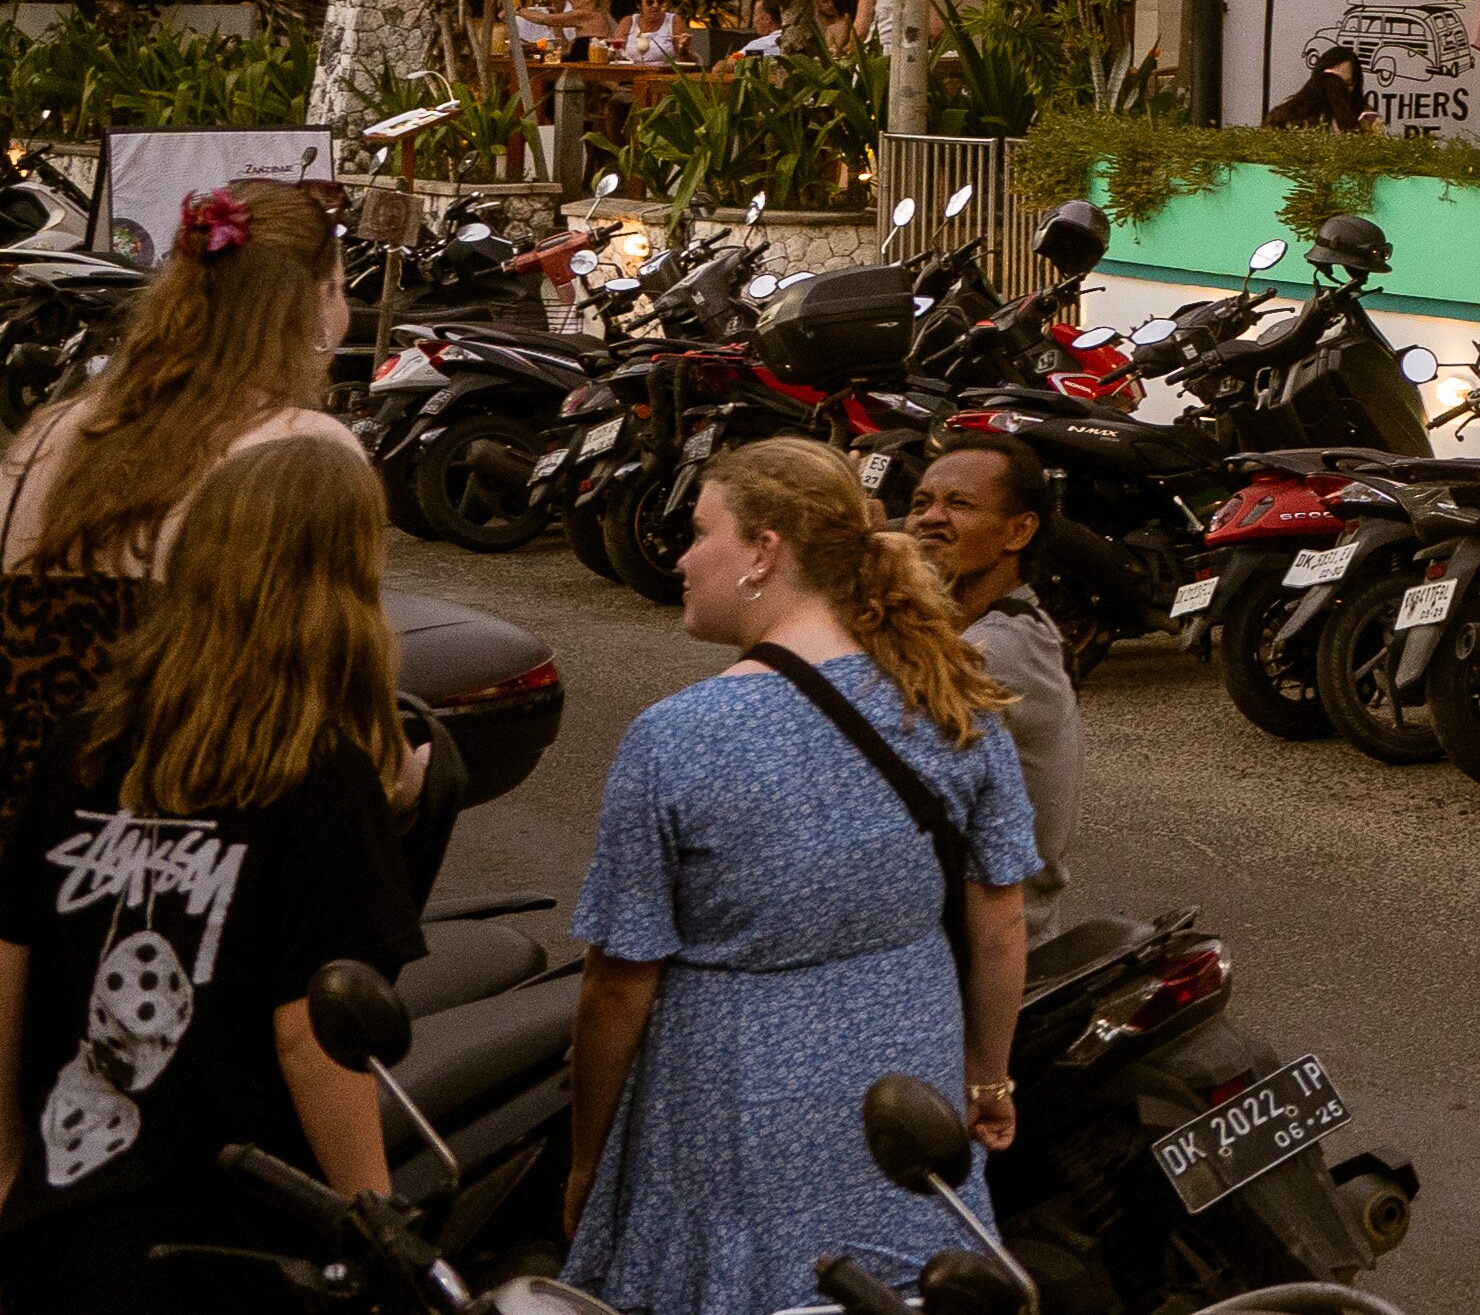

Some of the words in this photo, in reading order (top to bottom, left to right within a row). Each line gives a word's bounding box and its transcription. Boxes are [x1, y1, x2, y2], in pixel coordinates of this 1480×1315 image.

[1066, 423, 1120, 440] NMAX
[1162, 1136, 1208, 1179] DK
[1213, 1087, 1287, 1152] 2022
[1290, 1061, 1325, 1099] IP
